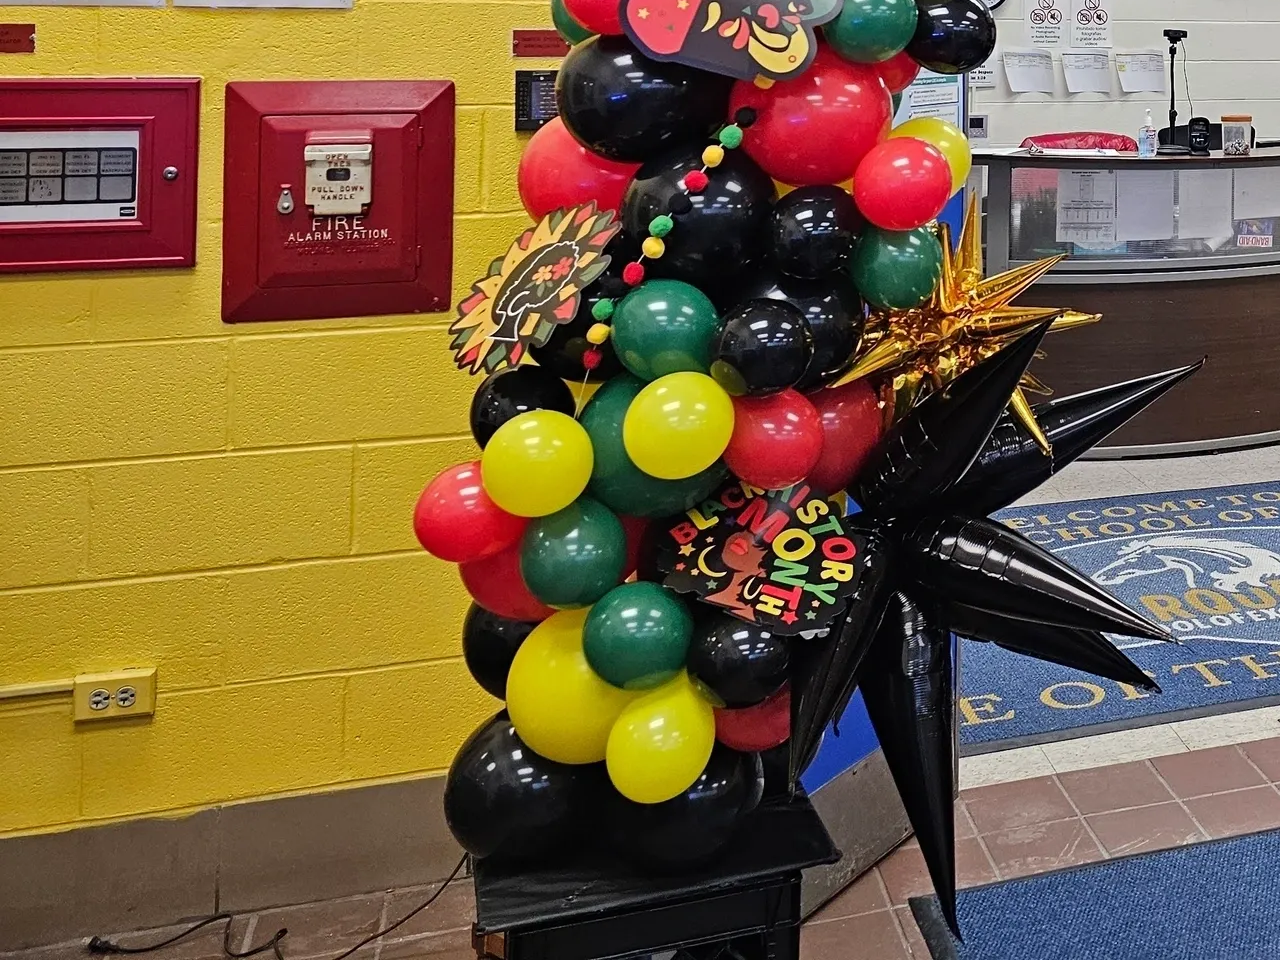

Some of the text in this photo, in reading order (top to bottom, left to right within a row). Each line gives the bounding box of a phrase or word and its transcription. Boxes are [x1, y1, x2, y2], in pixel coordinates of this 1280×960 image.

[311, 185, 365, 193] PULL DOWN
[321, 193, 355, 201] HANDLE
[312, 215, 365, 231] FIRE
[288, 228, 388, 242] ALARM STATION
[1238, 235, 1270, 246] BAND-AID
[1217, 505, 1280, 524] OF
[668, 480, 857, 606] BLACK HISTORY
[736, 496, 817, 616] MONTH
[1210, 612, 1246, 626] OF
